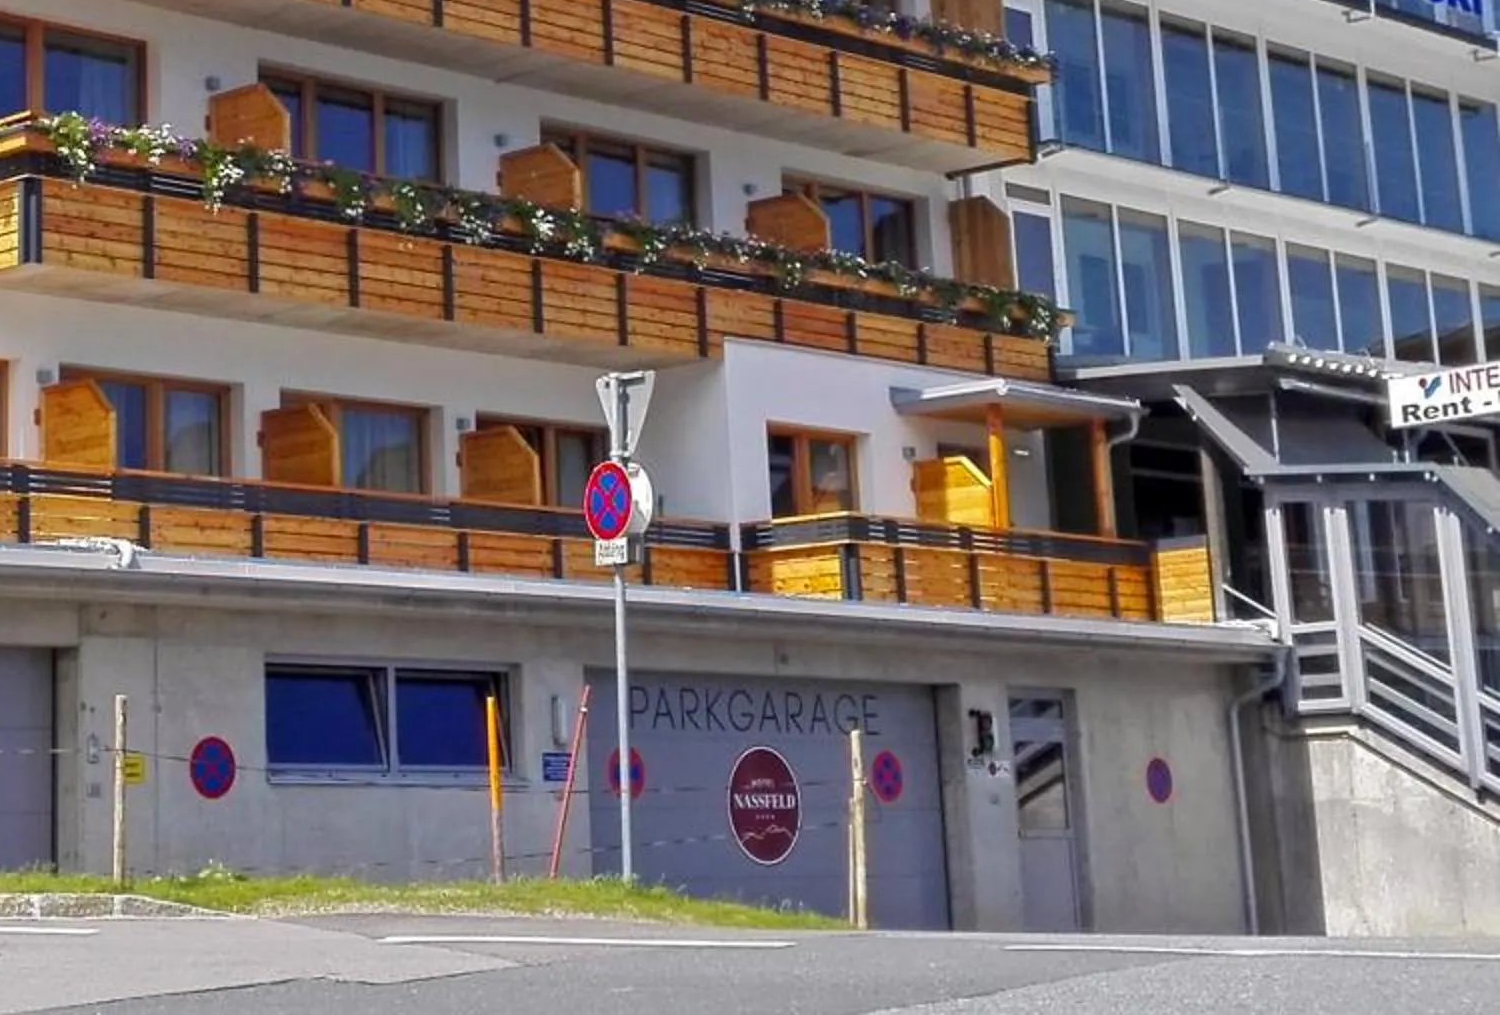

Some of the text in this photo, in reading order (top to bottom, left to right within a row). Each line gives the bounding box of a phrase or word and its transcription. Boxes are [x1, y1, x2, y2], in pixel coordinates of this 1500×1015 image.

[1402, 396, 1472, 423] Rent
[629, 686, 881, 736] PARKGARAGE
[733, 793, 797, 810] NASSFELD
